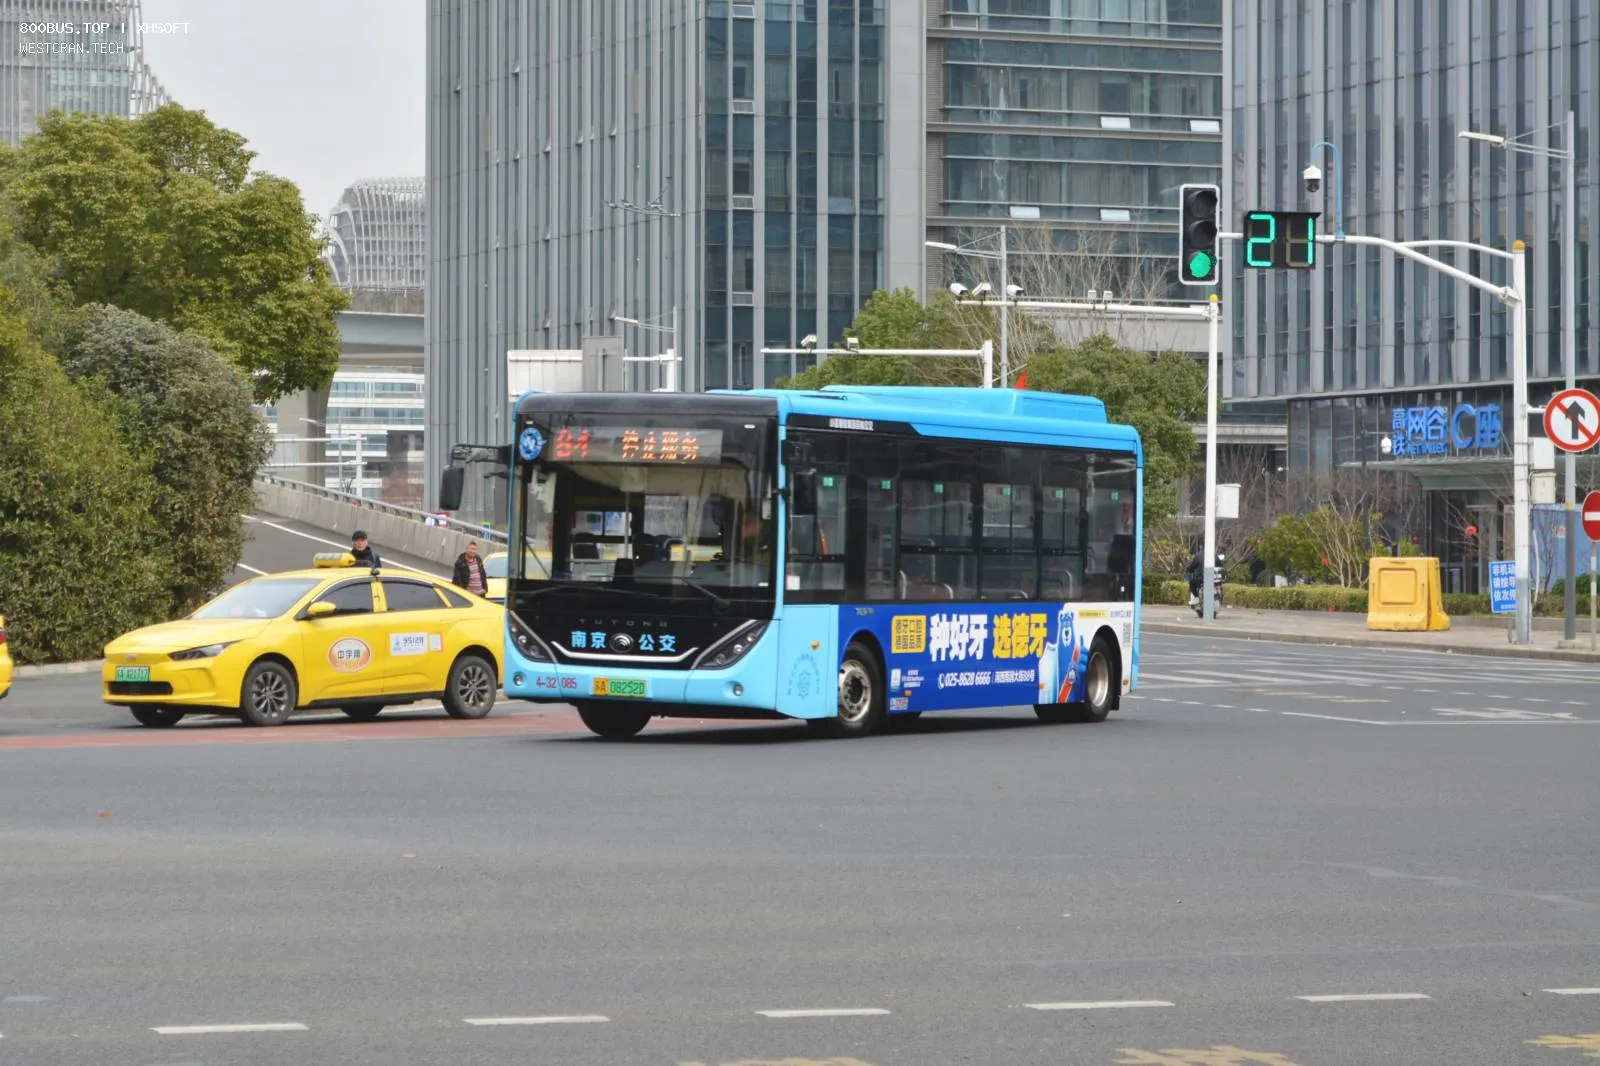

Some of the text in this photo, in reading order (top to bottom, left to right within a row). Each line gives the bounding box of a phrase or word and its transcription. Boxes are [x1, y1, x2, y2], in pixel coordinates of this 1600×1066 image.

[1246, 213, 1314, 267] 21
[571, 630, 677, 652] 南京 公交
[930, 613, 1048, 662] 种好牙 选德牙
